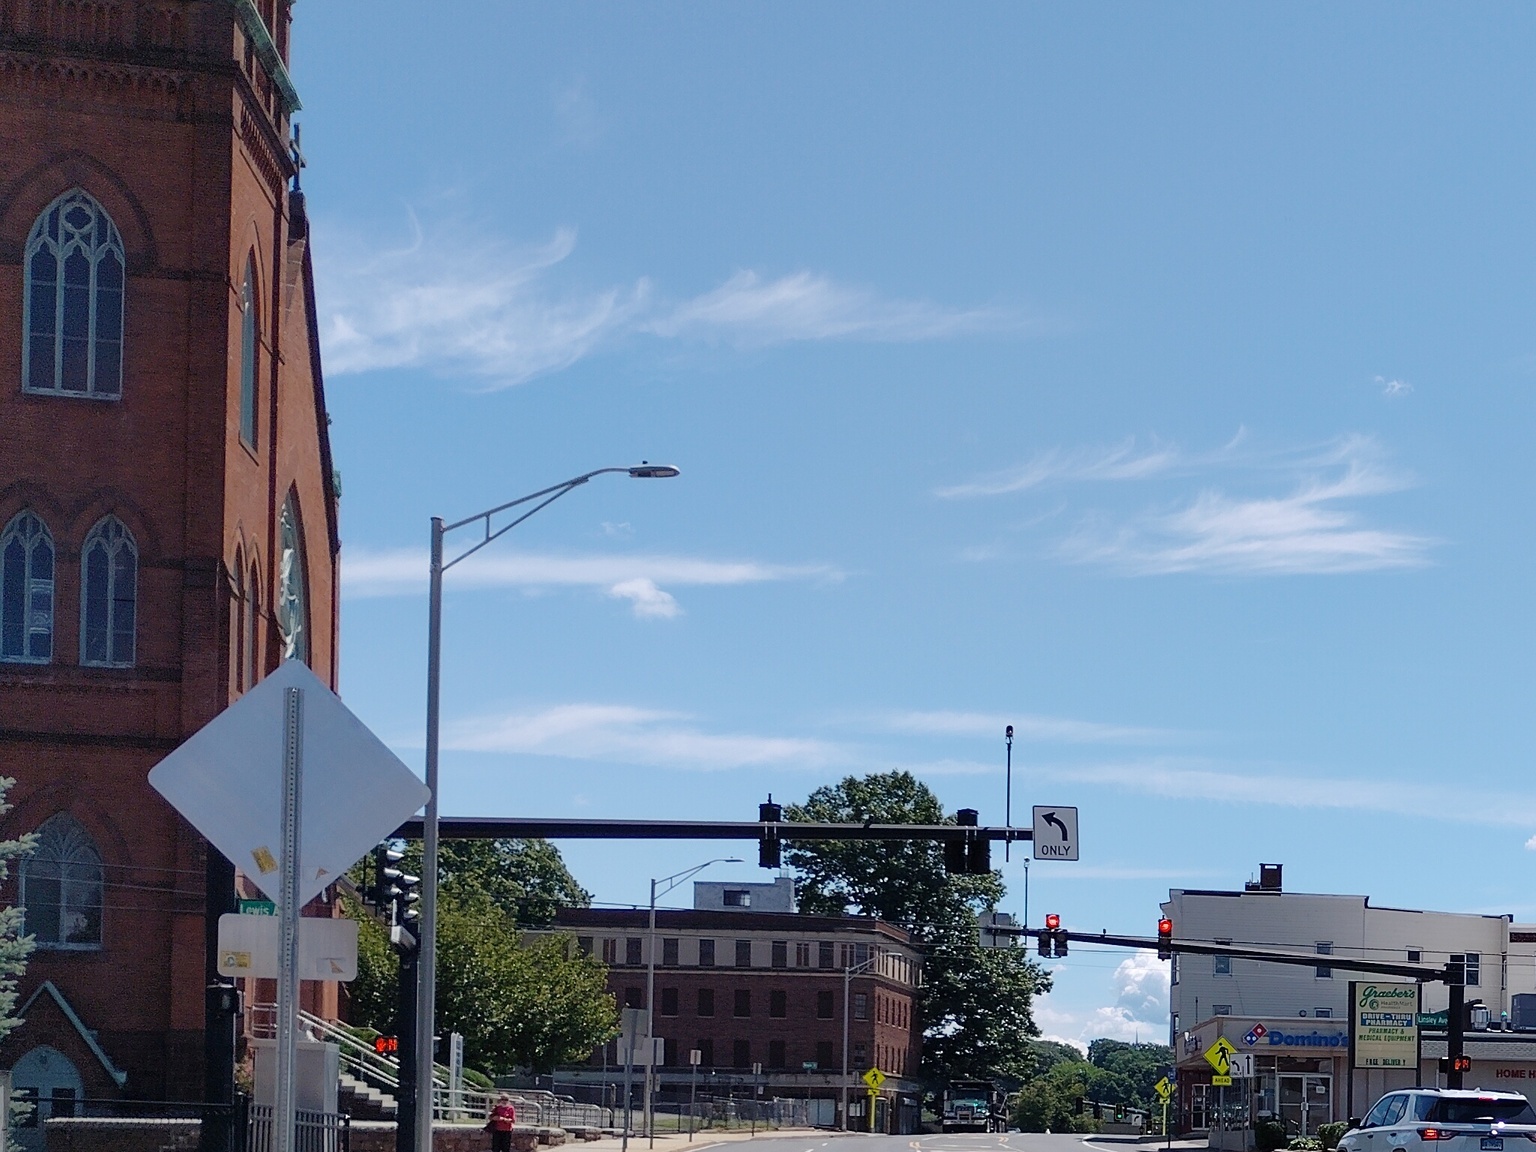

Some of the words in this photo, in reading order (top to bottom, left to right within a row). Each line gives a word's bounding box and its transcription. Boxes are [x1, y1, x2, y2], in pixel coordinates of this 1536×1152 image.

[1042, 845, 1071, 856] ONLY
[240, 903, 270, 916] Lewis
[1359, 985, 1415, 1007] Graeber's
[1269, 1030, 1349, 1047] Domino's
[1496, 1068, 1526, 1079] HOME
